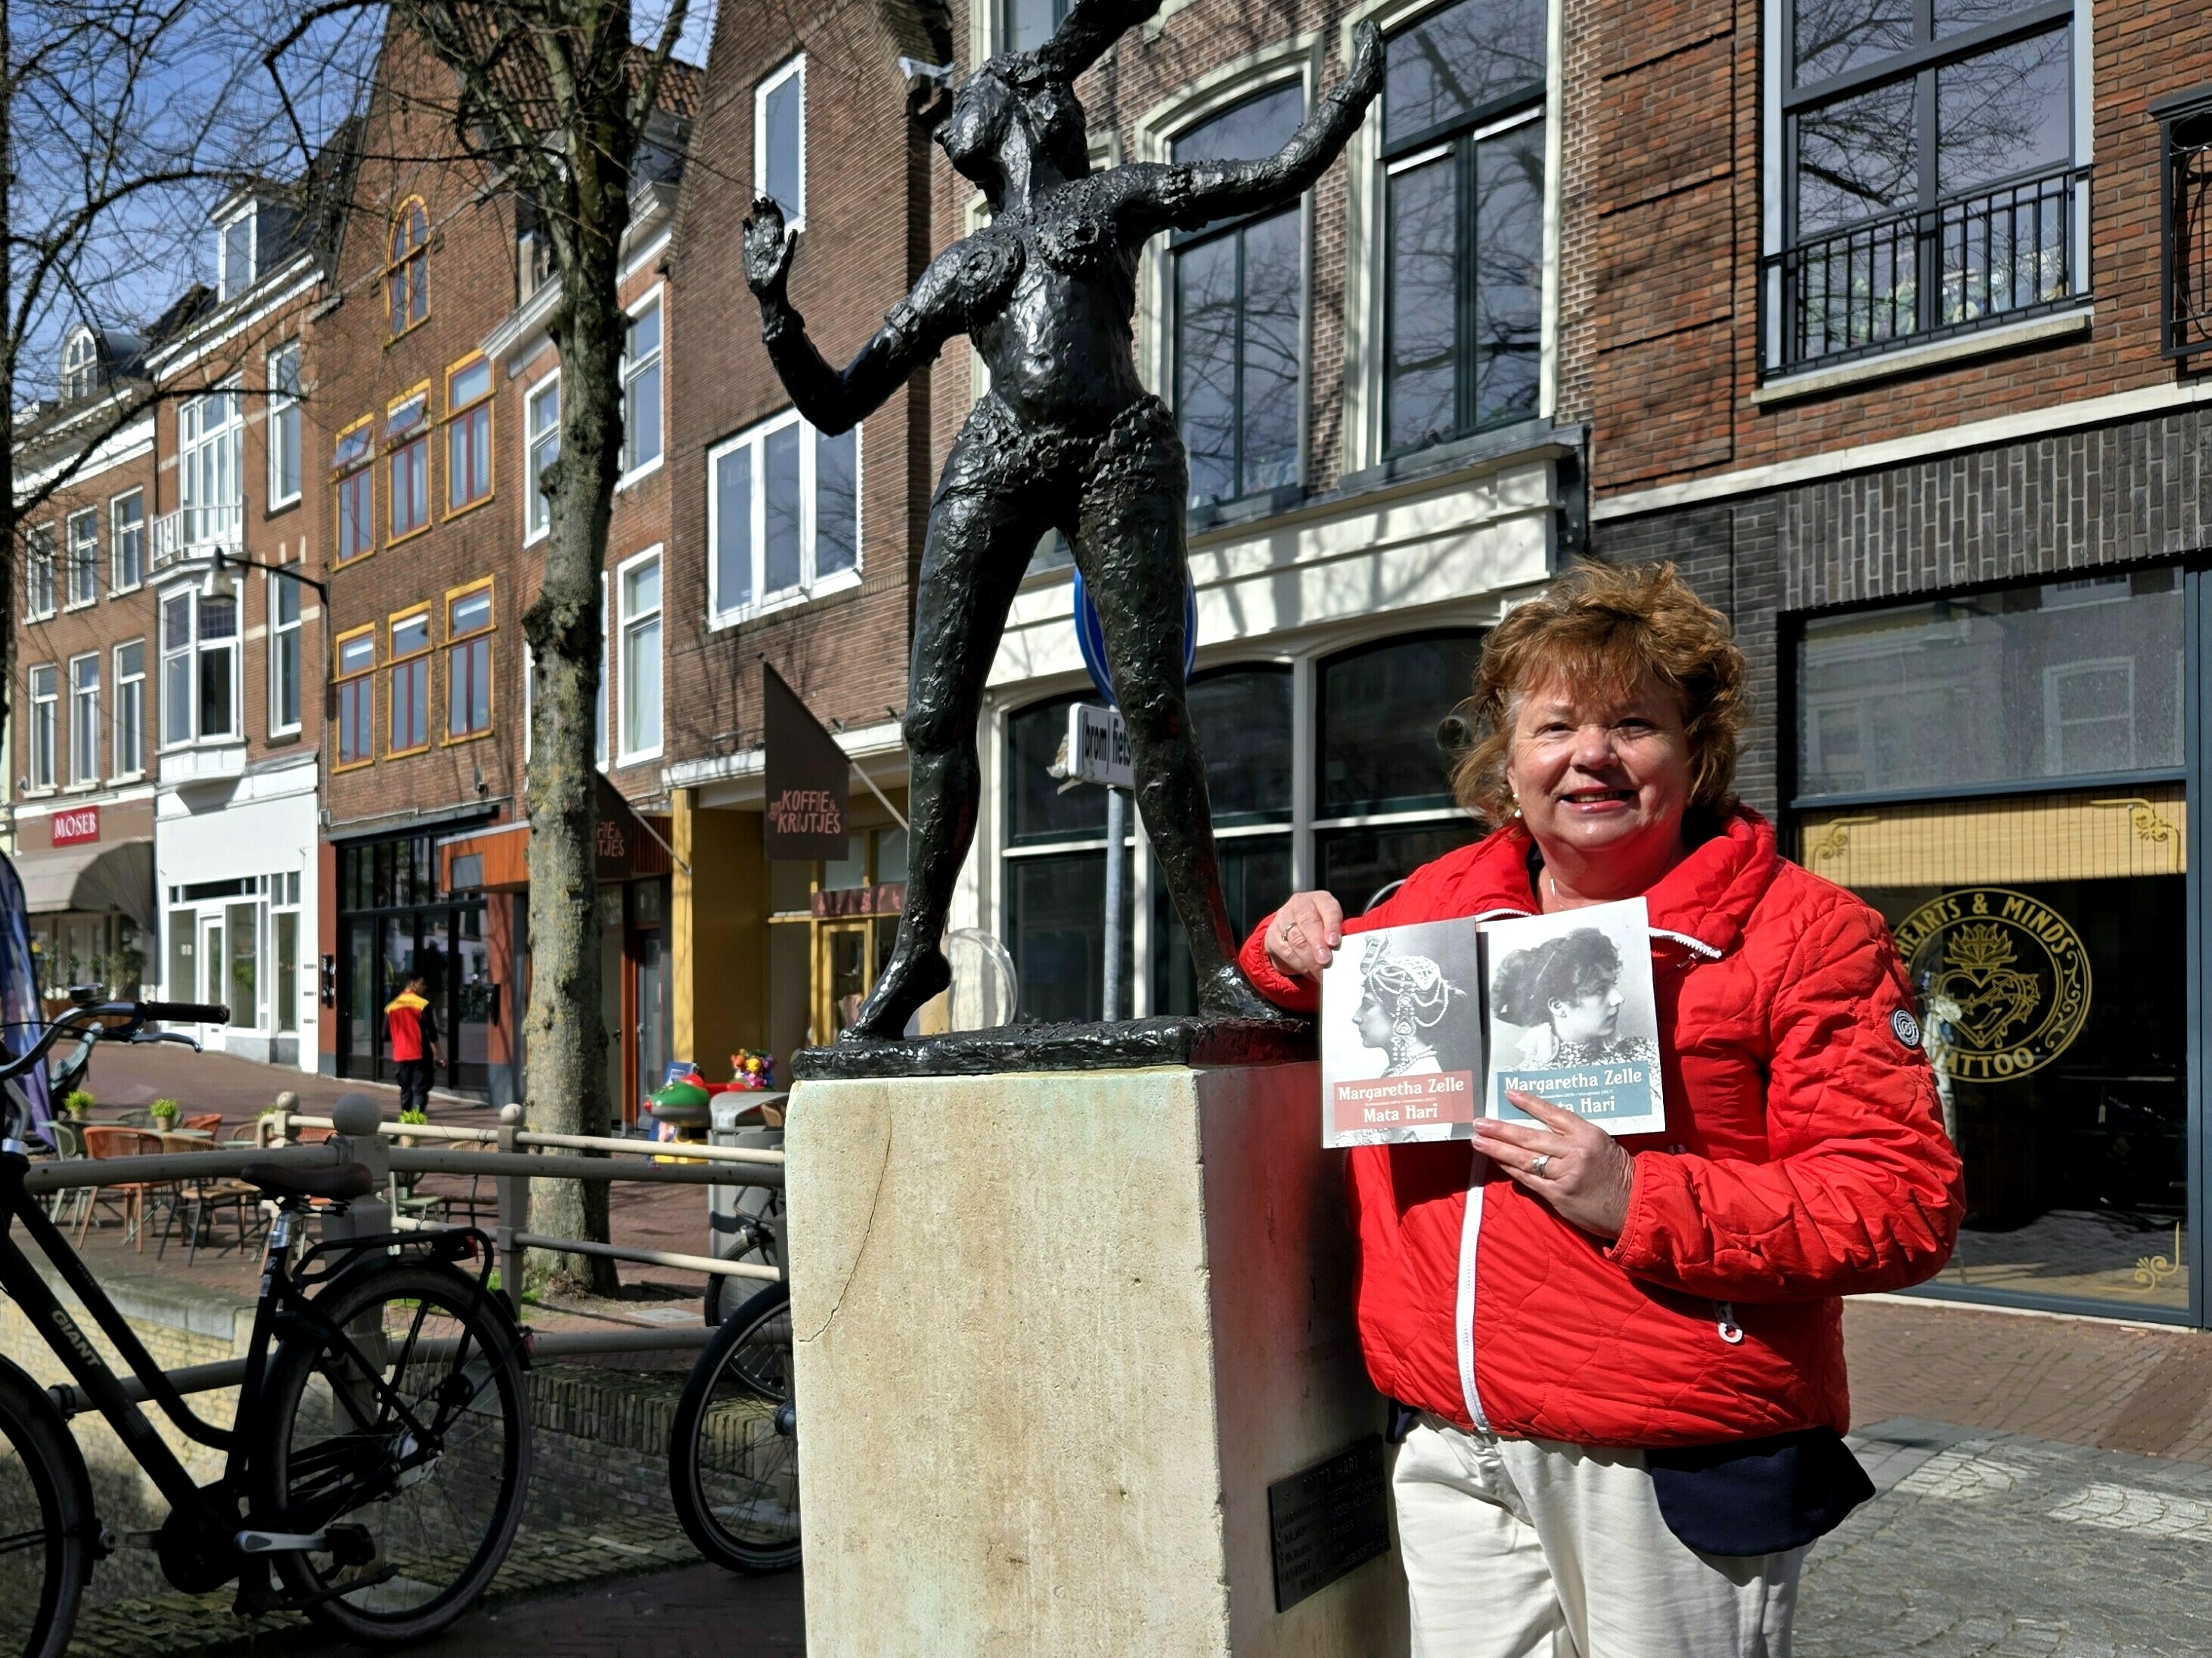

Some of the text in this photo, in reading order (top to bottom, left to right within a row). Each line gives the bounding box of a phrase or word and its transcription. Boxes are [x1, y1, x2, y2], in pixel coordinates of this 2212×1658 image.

[781, 790, 830, 812] KOFFIE
[777, 812, 841, 834] KRIJTJES
[597, 839, 625, 857] TJES
[1895, 893, 2074, 957] HEARTS & MINDS
[1942, 1047, 2034, 1078] ATTOO
[1339, 1081, 1422, 1102] Margaretha
[1428, 1077, 1465, 1092] Zelle
[1505, 1068, 1642, 1093] Margaretha Zelle
[1363, 1103, 1438, 1123] Mata Hari
[1558, 1096, 1615, 1114] ta Hari
[51, 1310, 101, 1365] GIANT
[1336, 1455, 1358, 1478] HARI
